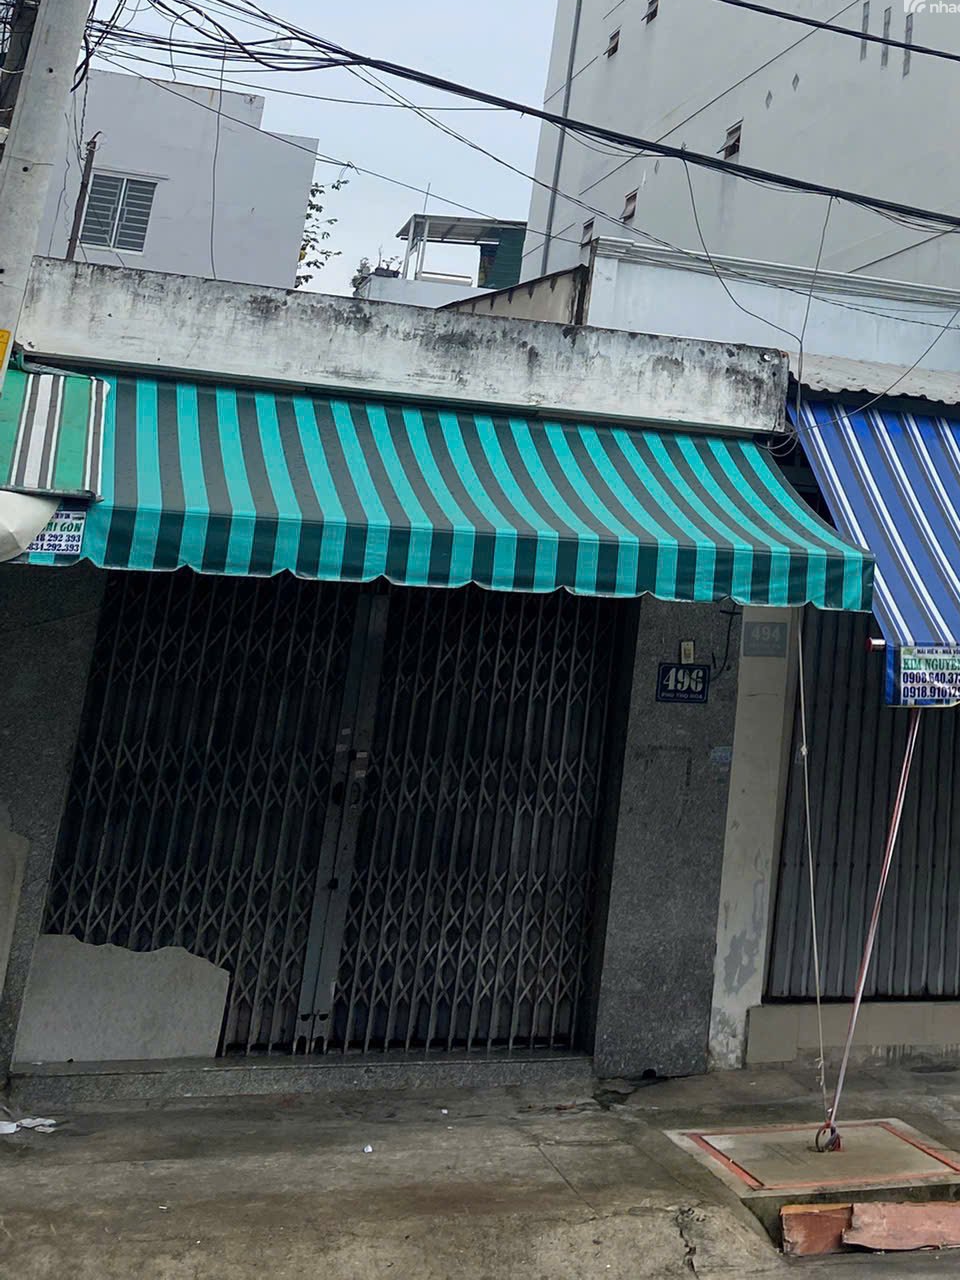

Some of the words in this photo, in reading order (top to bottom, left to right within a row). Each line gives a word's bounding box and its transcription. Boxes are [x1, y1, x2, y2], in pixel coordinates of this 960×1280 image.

[47, 534, 63, 542] 292
[65, 534, 81, 543] 393
[903, 658, 922, 671] KIM
[663, 668, 704, 693] 496
